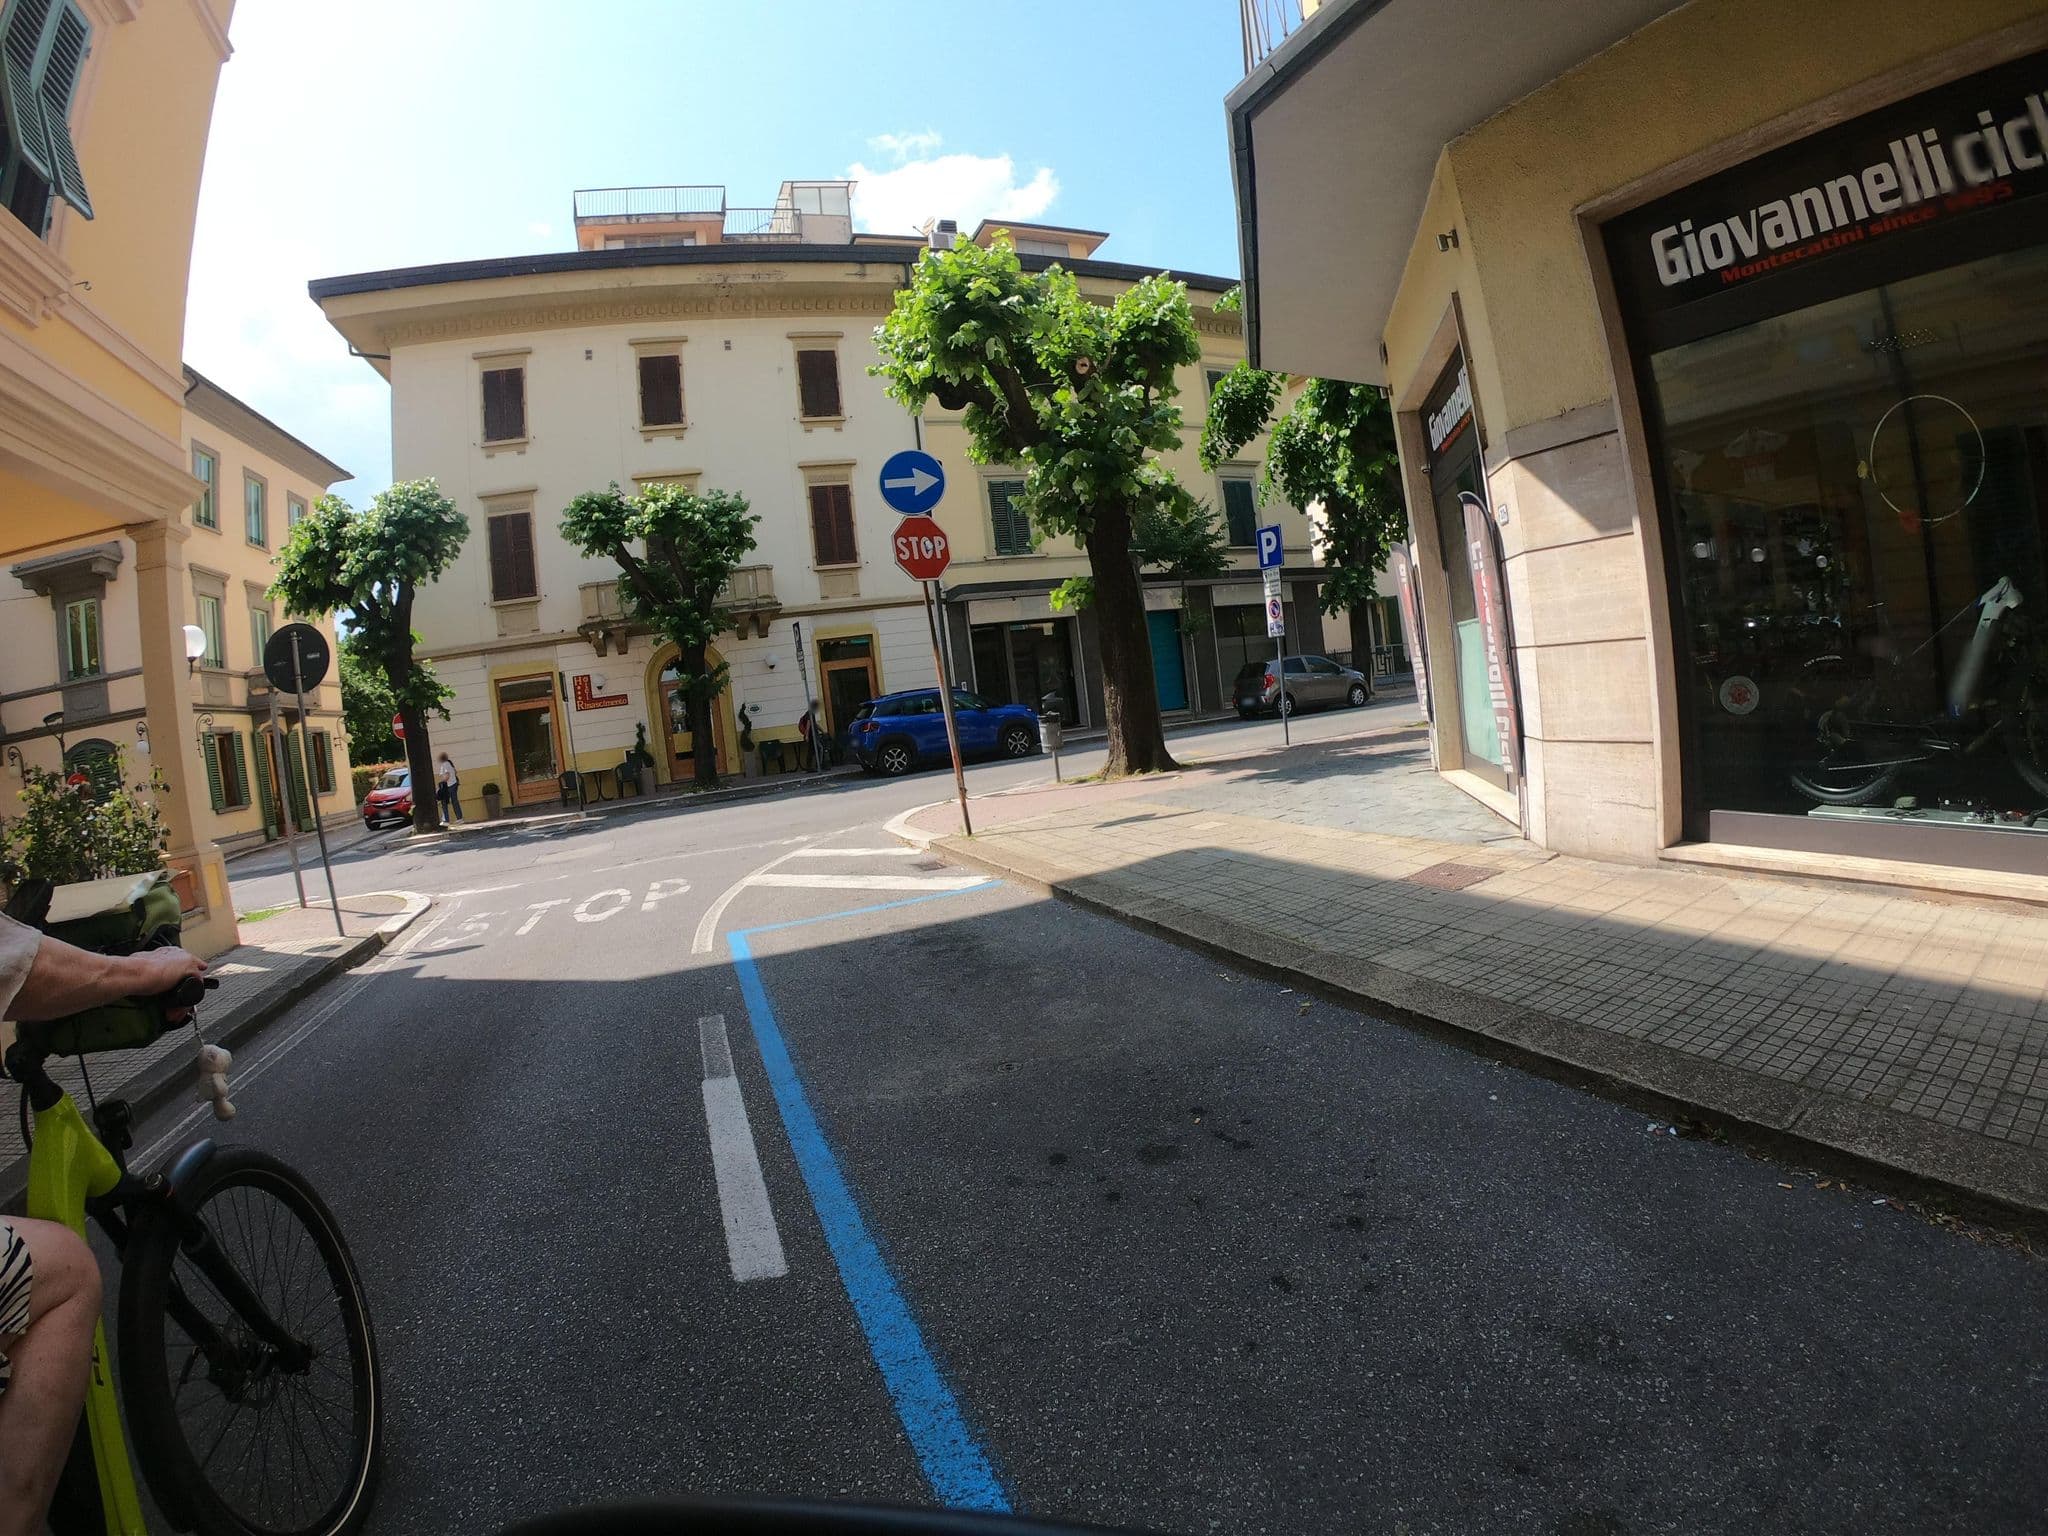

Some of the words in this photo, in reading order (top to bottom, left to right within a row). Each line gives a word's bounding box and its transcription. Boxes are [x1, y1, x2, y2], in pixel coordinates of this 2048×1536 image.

[1650, 128, 1957, 287] Giovannelli
[1952, 91, 2048, 187] cicl
[1721, 225, 1865, 284] Montecatini
[896, 536, 946, 560] STOP
[1261, 531, 1277, 565] P
[431, 878, 691, 949] STOP
